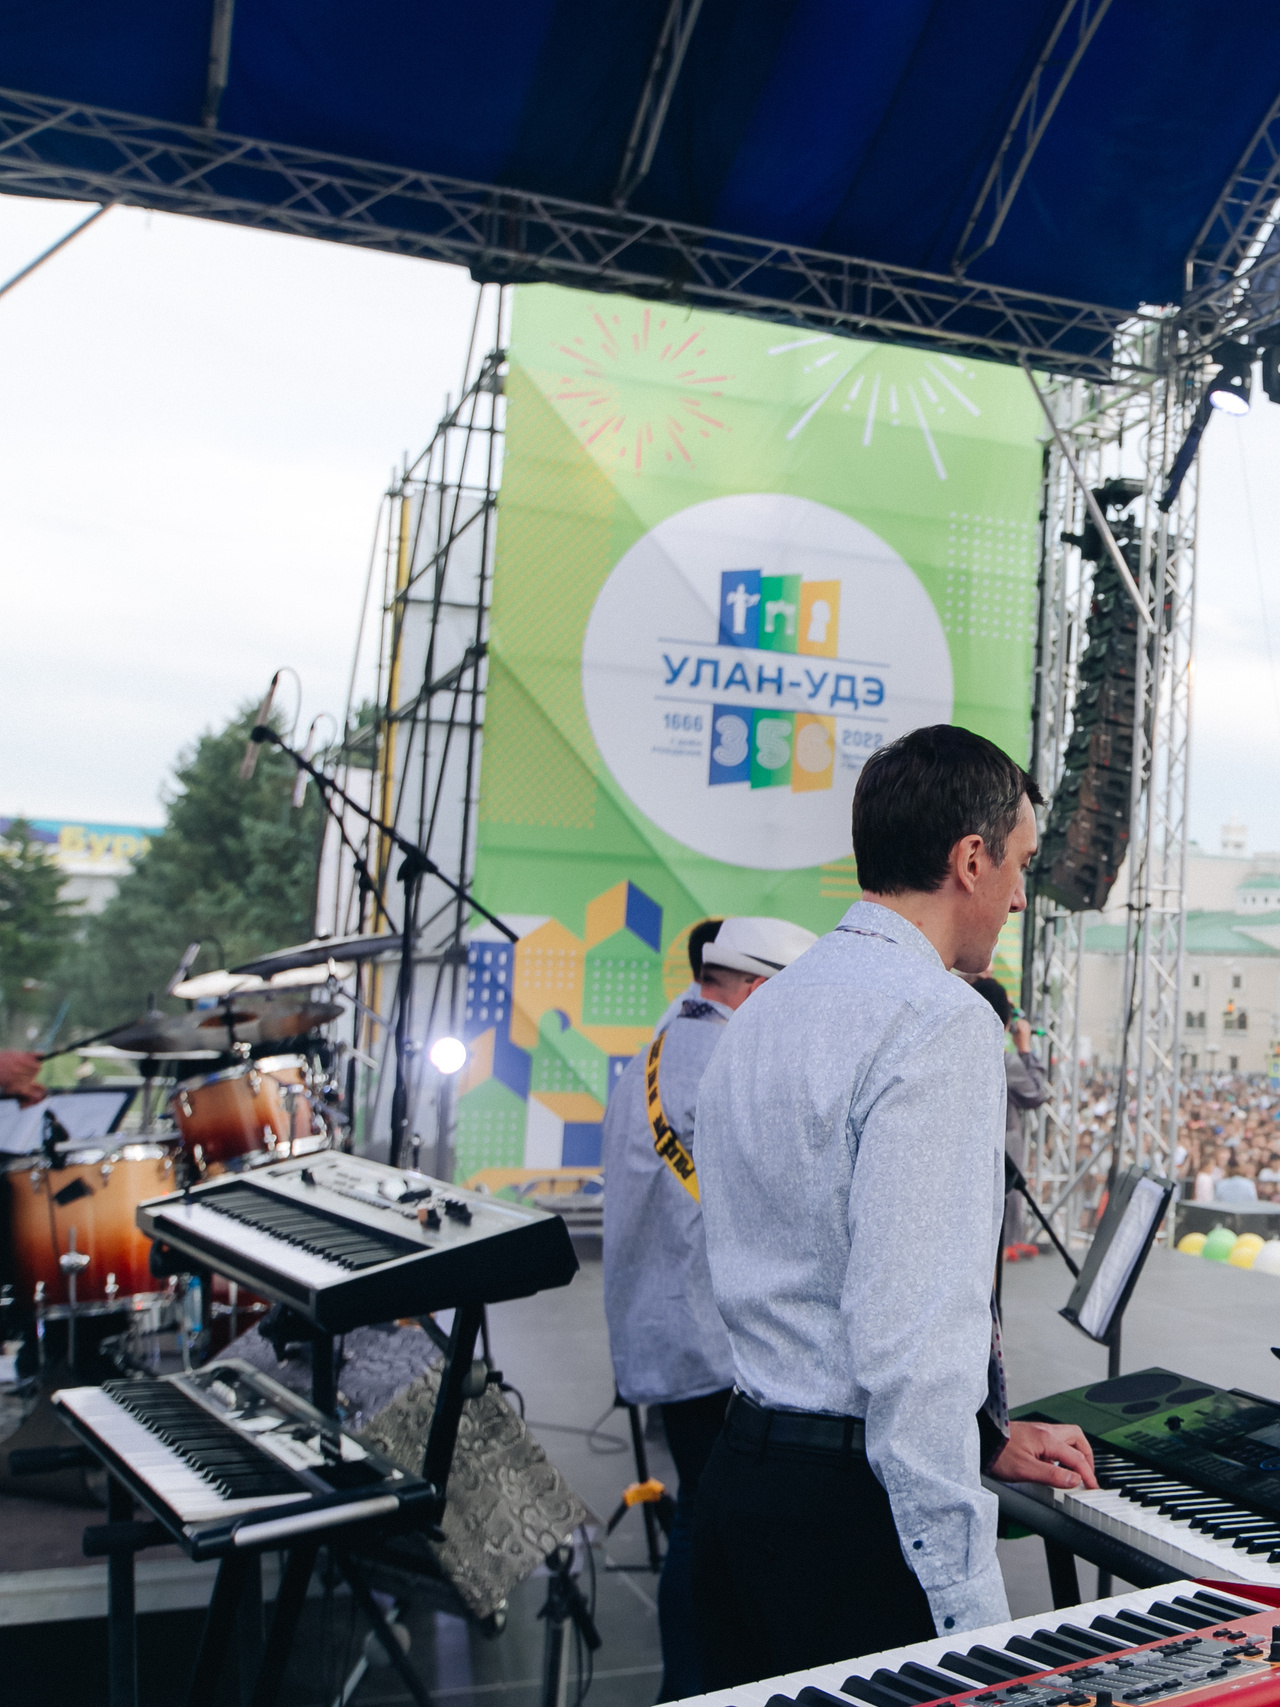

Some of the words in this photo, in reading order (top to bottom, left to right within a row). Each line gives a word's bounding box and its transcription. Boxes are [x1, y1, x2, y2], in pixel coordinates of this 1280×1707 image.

[663, 654, 885, 711] УЛАН-УДЭ
[664, 712, 703, 733] 1666
[842, 728, 883, 751] 2022
